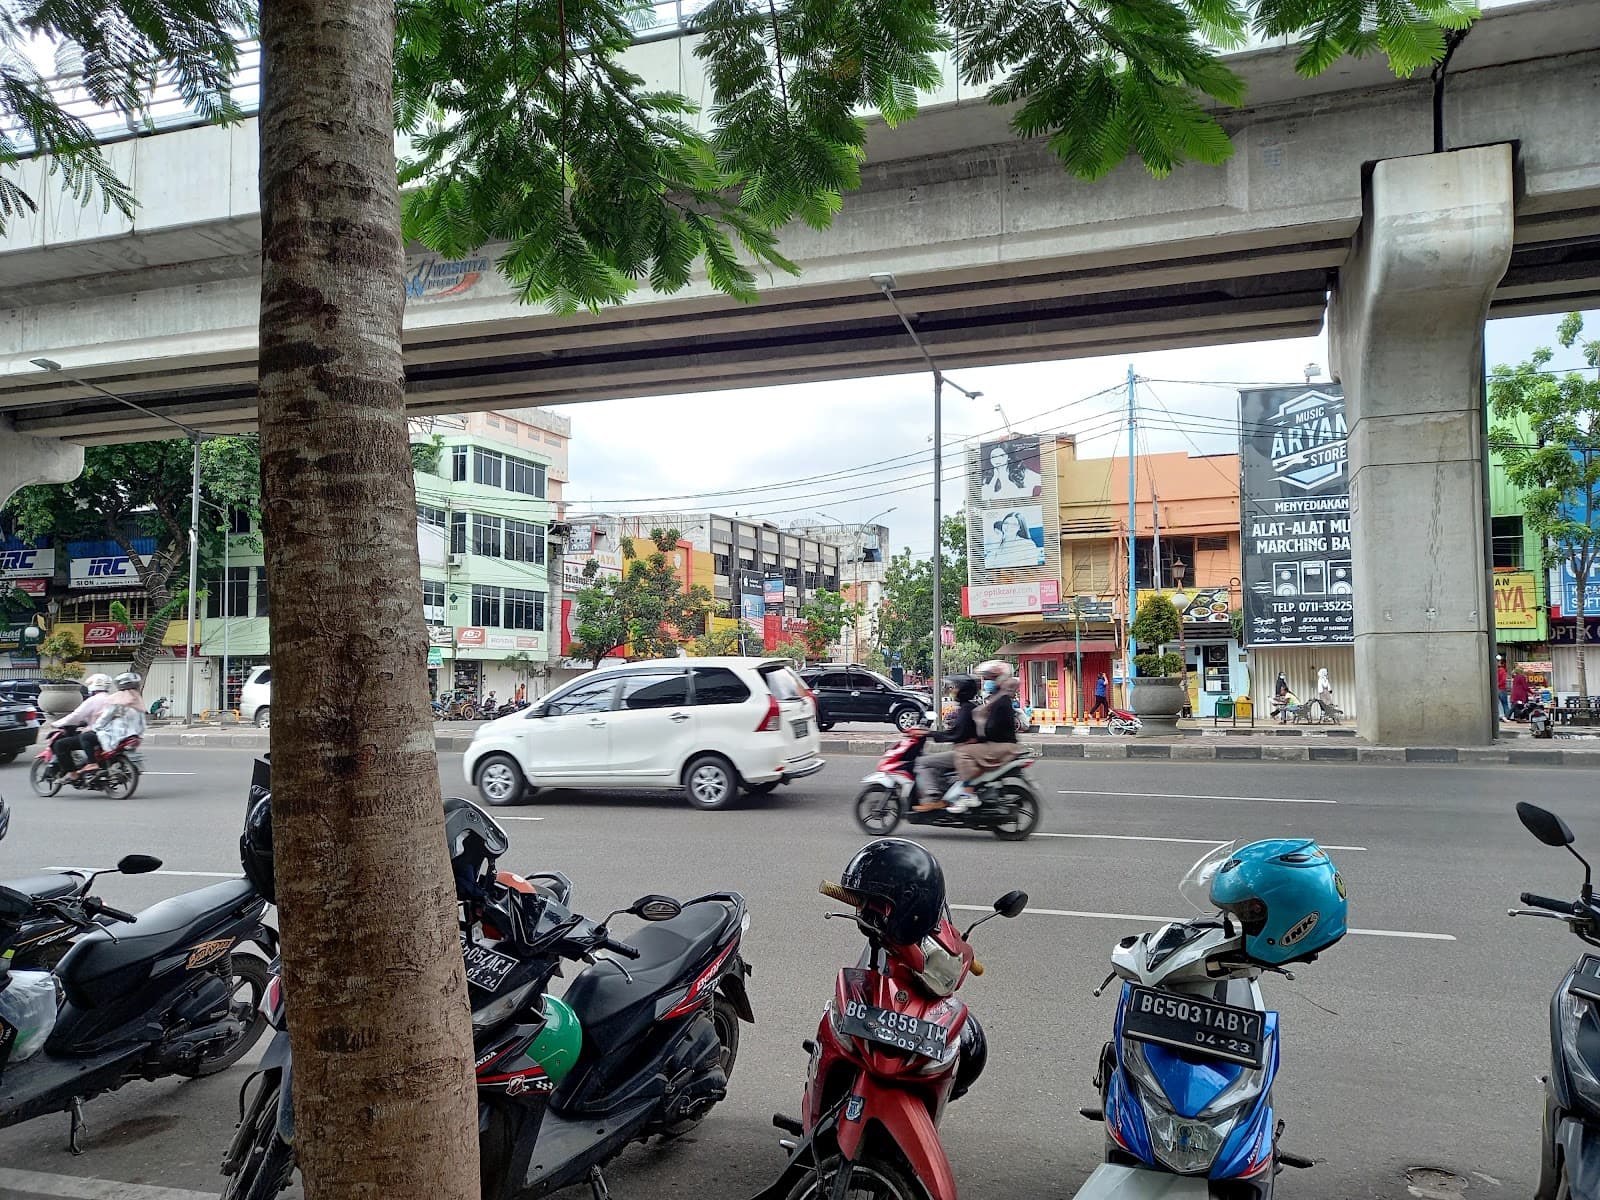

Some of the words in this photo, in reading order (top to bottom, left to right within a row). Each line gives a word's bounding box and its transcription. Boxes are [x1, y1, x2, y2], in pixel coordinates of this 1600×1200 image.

[1295, 406, 1325, 424] MUSIC
[1310, 445, 1347, 466] STORE
[1274, 498, 1349, 513] MENYEDIAKAN
[1252, 520, 1327, 537] ALAT-ALAT
[1256, 537, 1328, 554] MARCHING
[1272, 602, 1297, 613] TELP.
[1285, 916, 1314, 944] INK
[877, 1009, 918, 1035] 4859
[1141, 994, 1255, 1035] BG5031ABY
